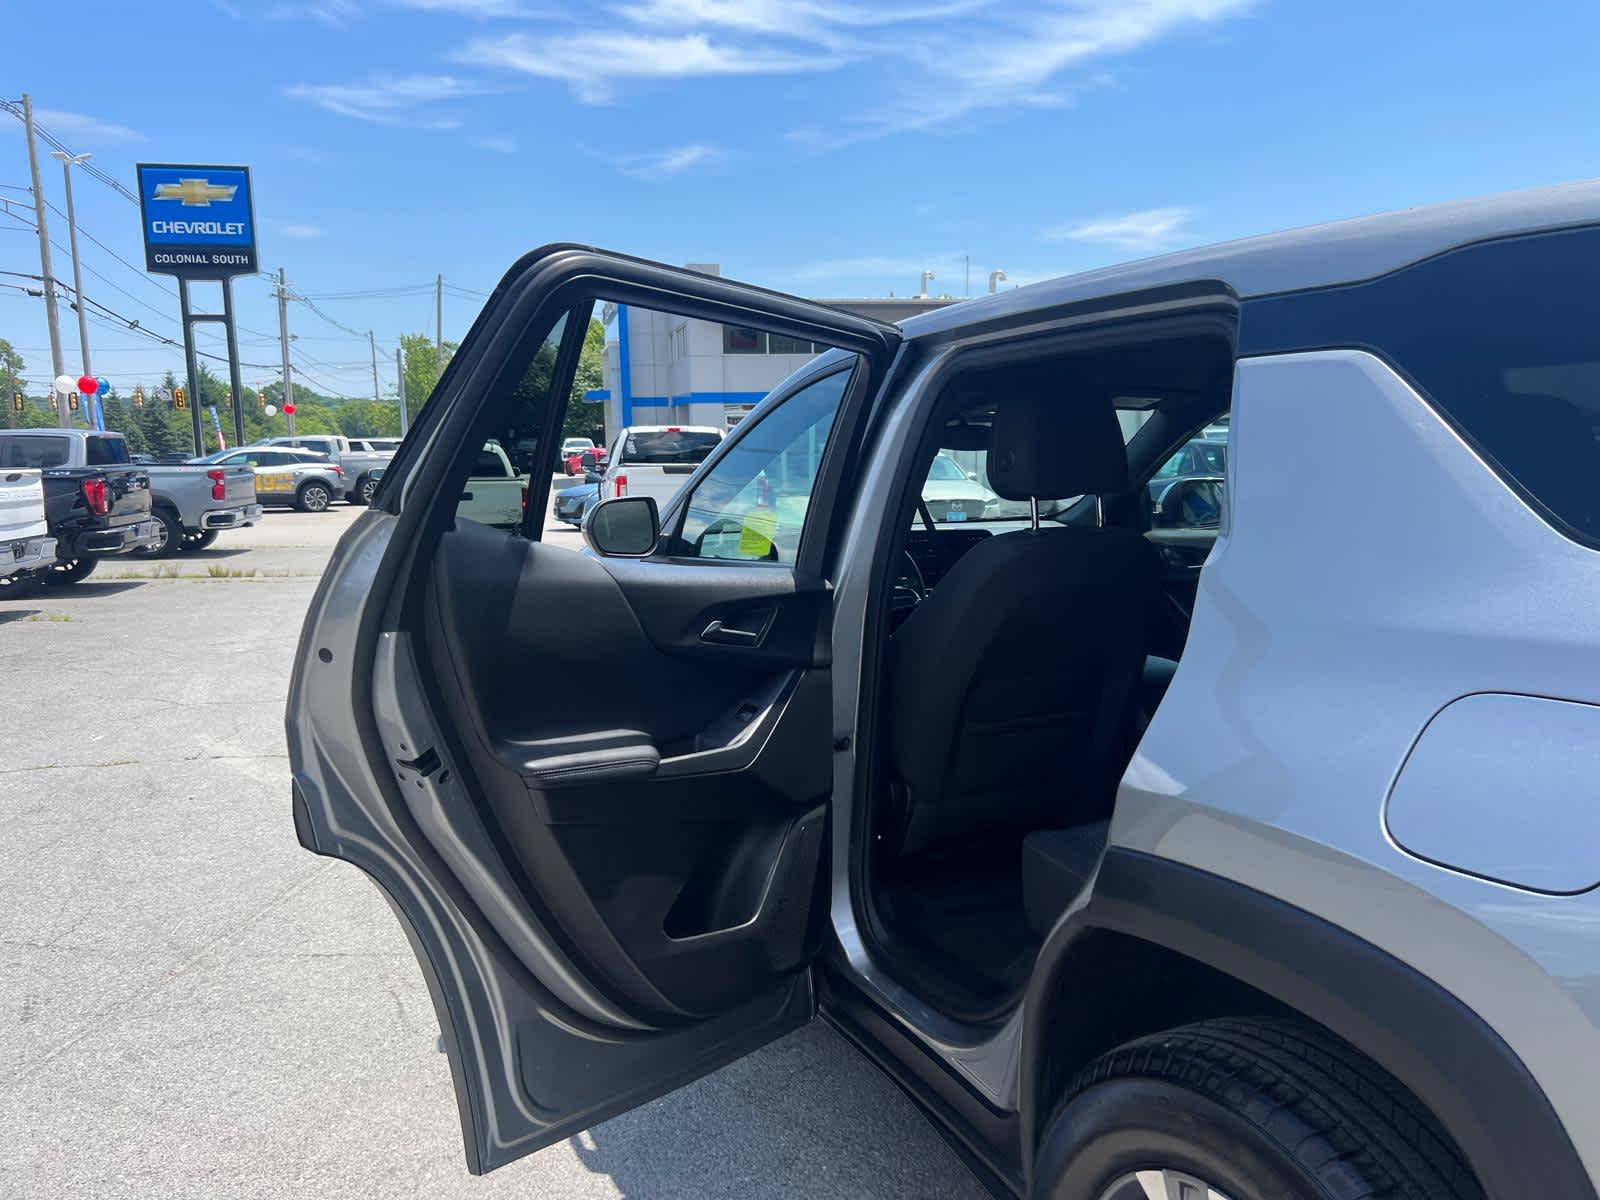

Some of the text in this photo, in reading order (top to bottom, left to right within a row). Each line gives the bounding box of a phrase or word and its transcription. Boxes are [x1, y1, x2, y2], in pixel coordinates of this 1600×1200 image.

[152, 221, 244, 235] CHEVROLET
[154, 254, 249, 265] COLONIAL SOUTH
